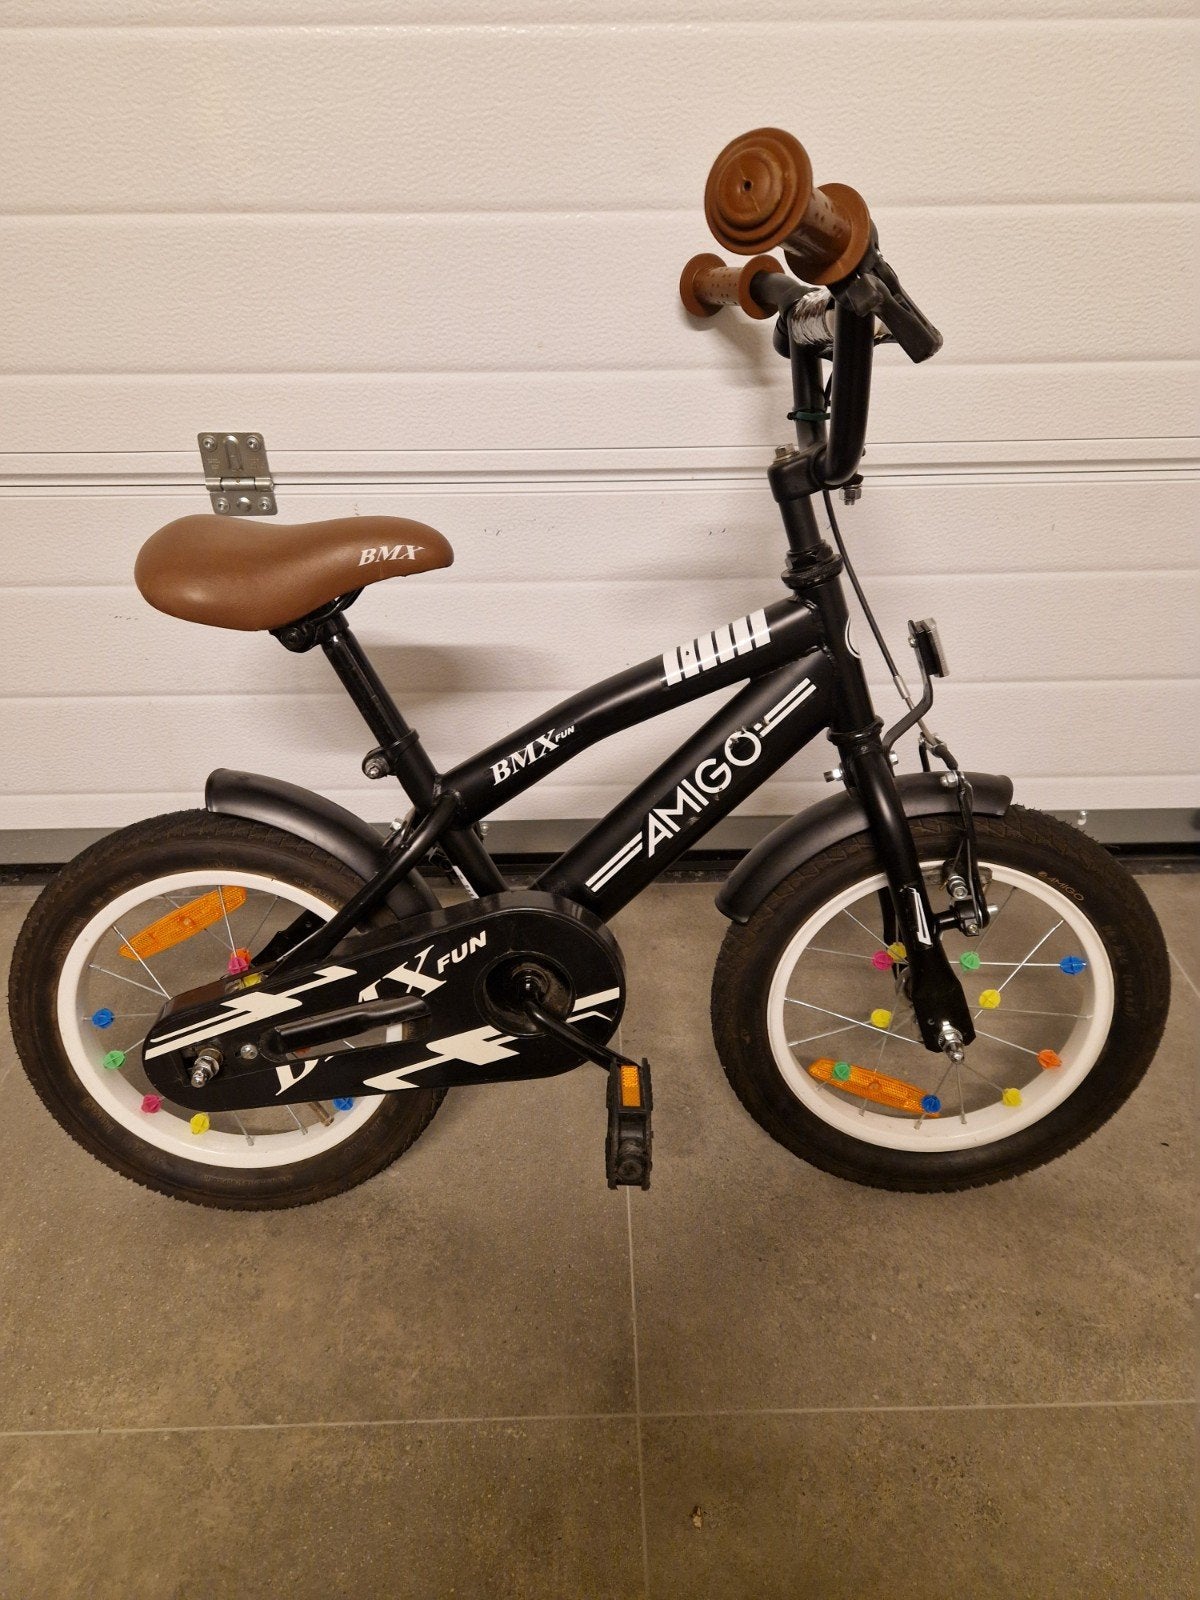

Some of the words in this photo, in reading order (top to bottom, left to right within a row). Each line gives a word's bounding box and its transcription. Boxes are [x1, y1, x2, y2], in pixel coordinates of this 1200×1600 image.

[358, 544, 426, 566] BMX
[489, 728, 560, 786] BMX
[555, 725, 575, 742] FUN
[648, 729, 762, 858] AMIGO
[1047, 877, 1085, 901] AMIGO
[437, 930, 487, 975] FUN
